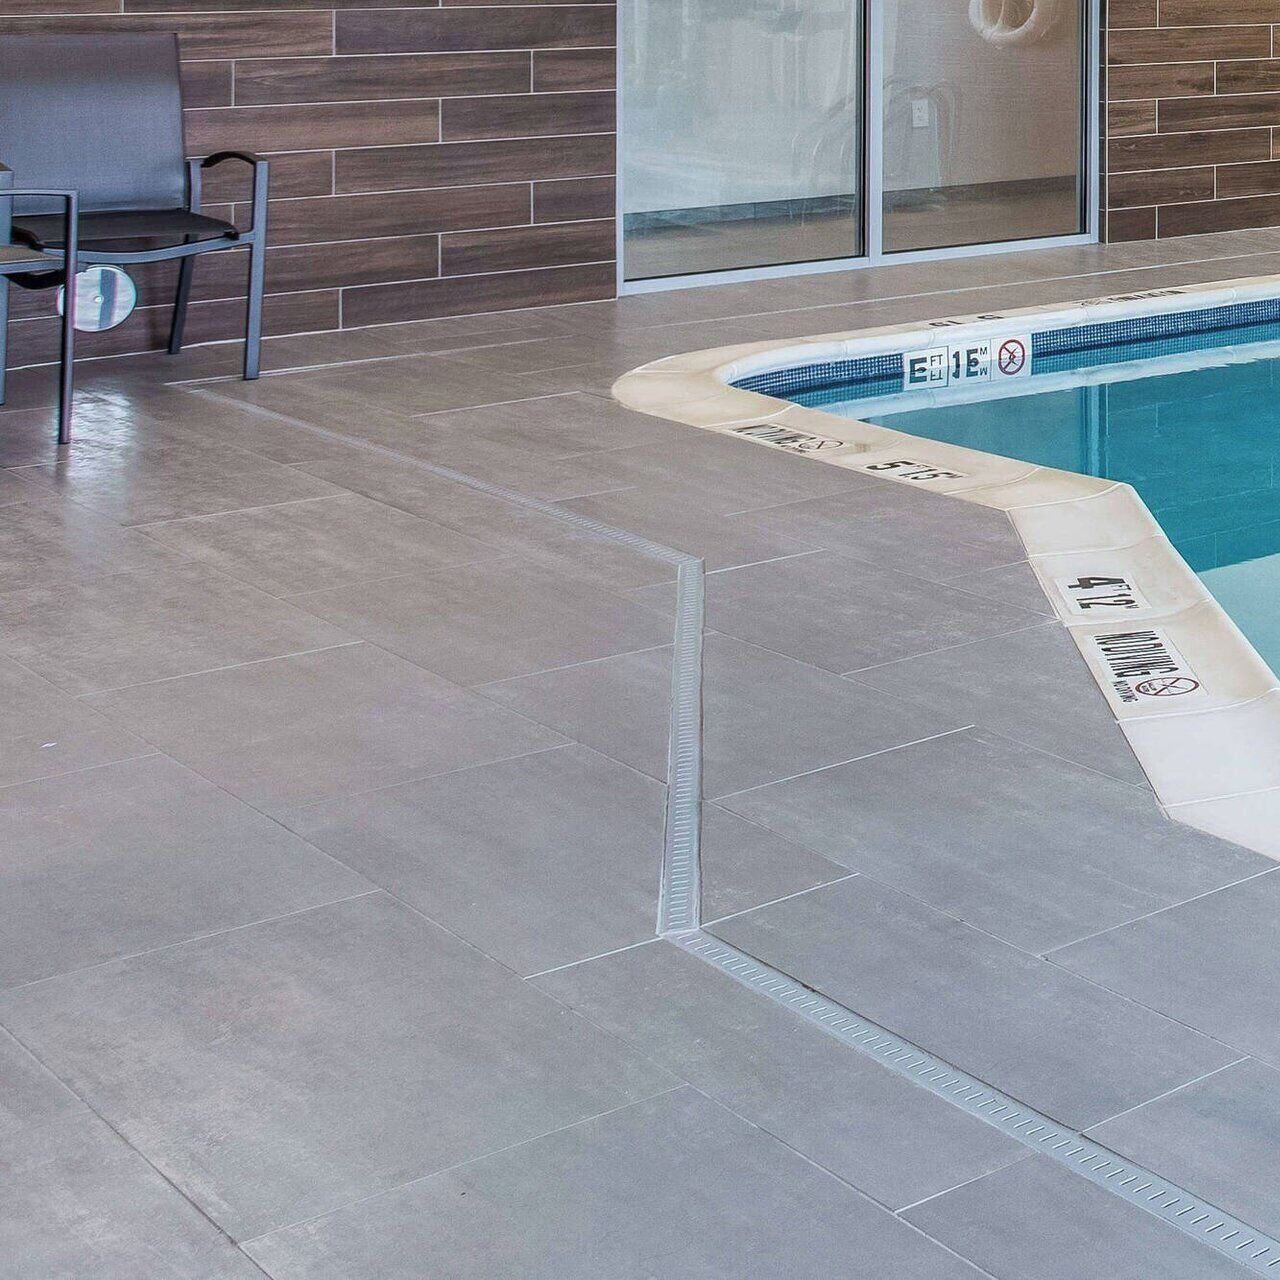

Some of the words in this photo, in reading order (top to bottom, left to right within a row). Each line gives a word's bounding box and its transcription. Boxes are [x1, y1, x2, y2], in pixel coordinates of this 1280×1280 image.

[930, 354, 943, 367] FT
[980, 346, 988, 356] M
[1067, 576, 1126, 589] 4
[1094, 630, 1160, 645] NO
[1101, 642, 1179, 678] DIVING
